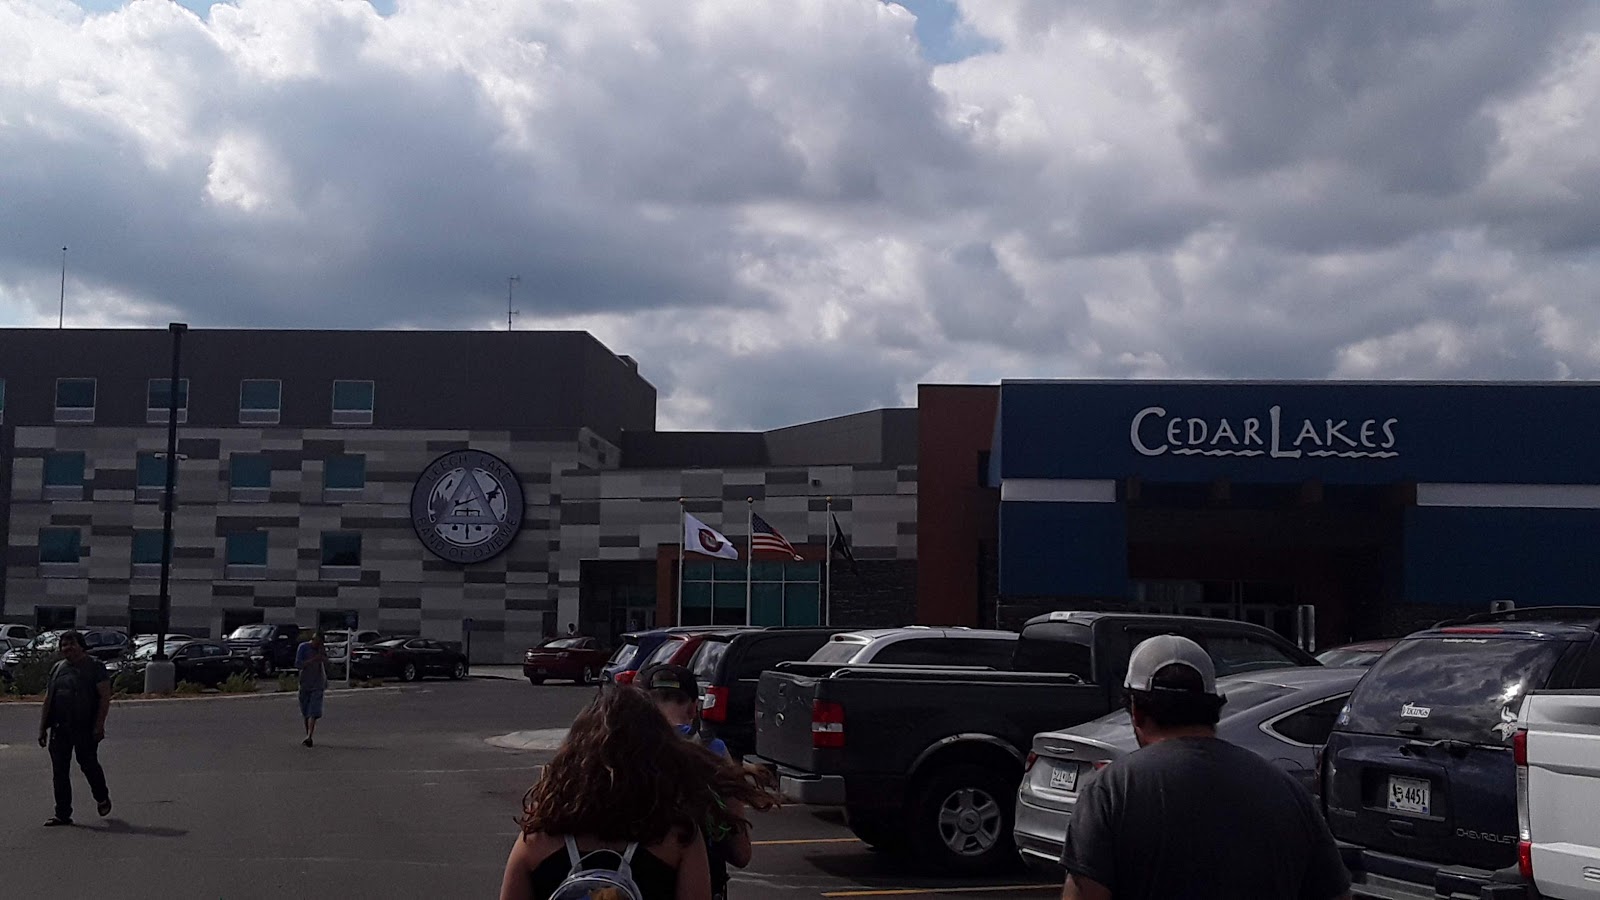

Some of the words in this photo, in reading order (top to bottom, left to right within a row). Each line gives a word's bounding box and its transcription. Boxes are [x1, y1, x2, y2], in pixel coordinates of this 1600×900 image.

[426, 455, 468, 482] LEECH
[480, 456, 513, 481] LAKE
[417, 517, 445, 551] BAND
[449, 547, 468, 559] OF
[474, 518, 517, 559] OJIBWE
[1456, 828, 1517, 844] CHEVROLET
